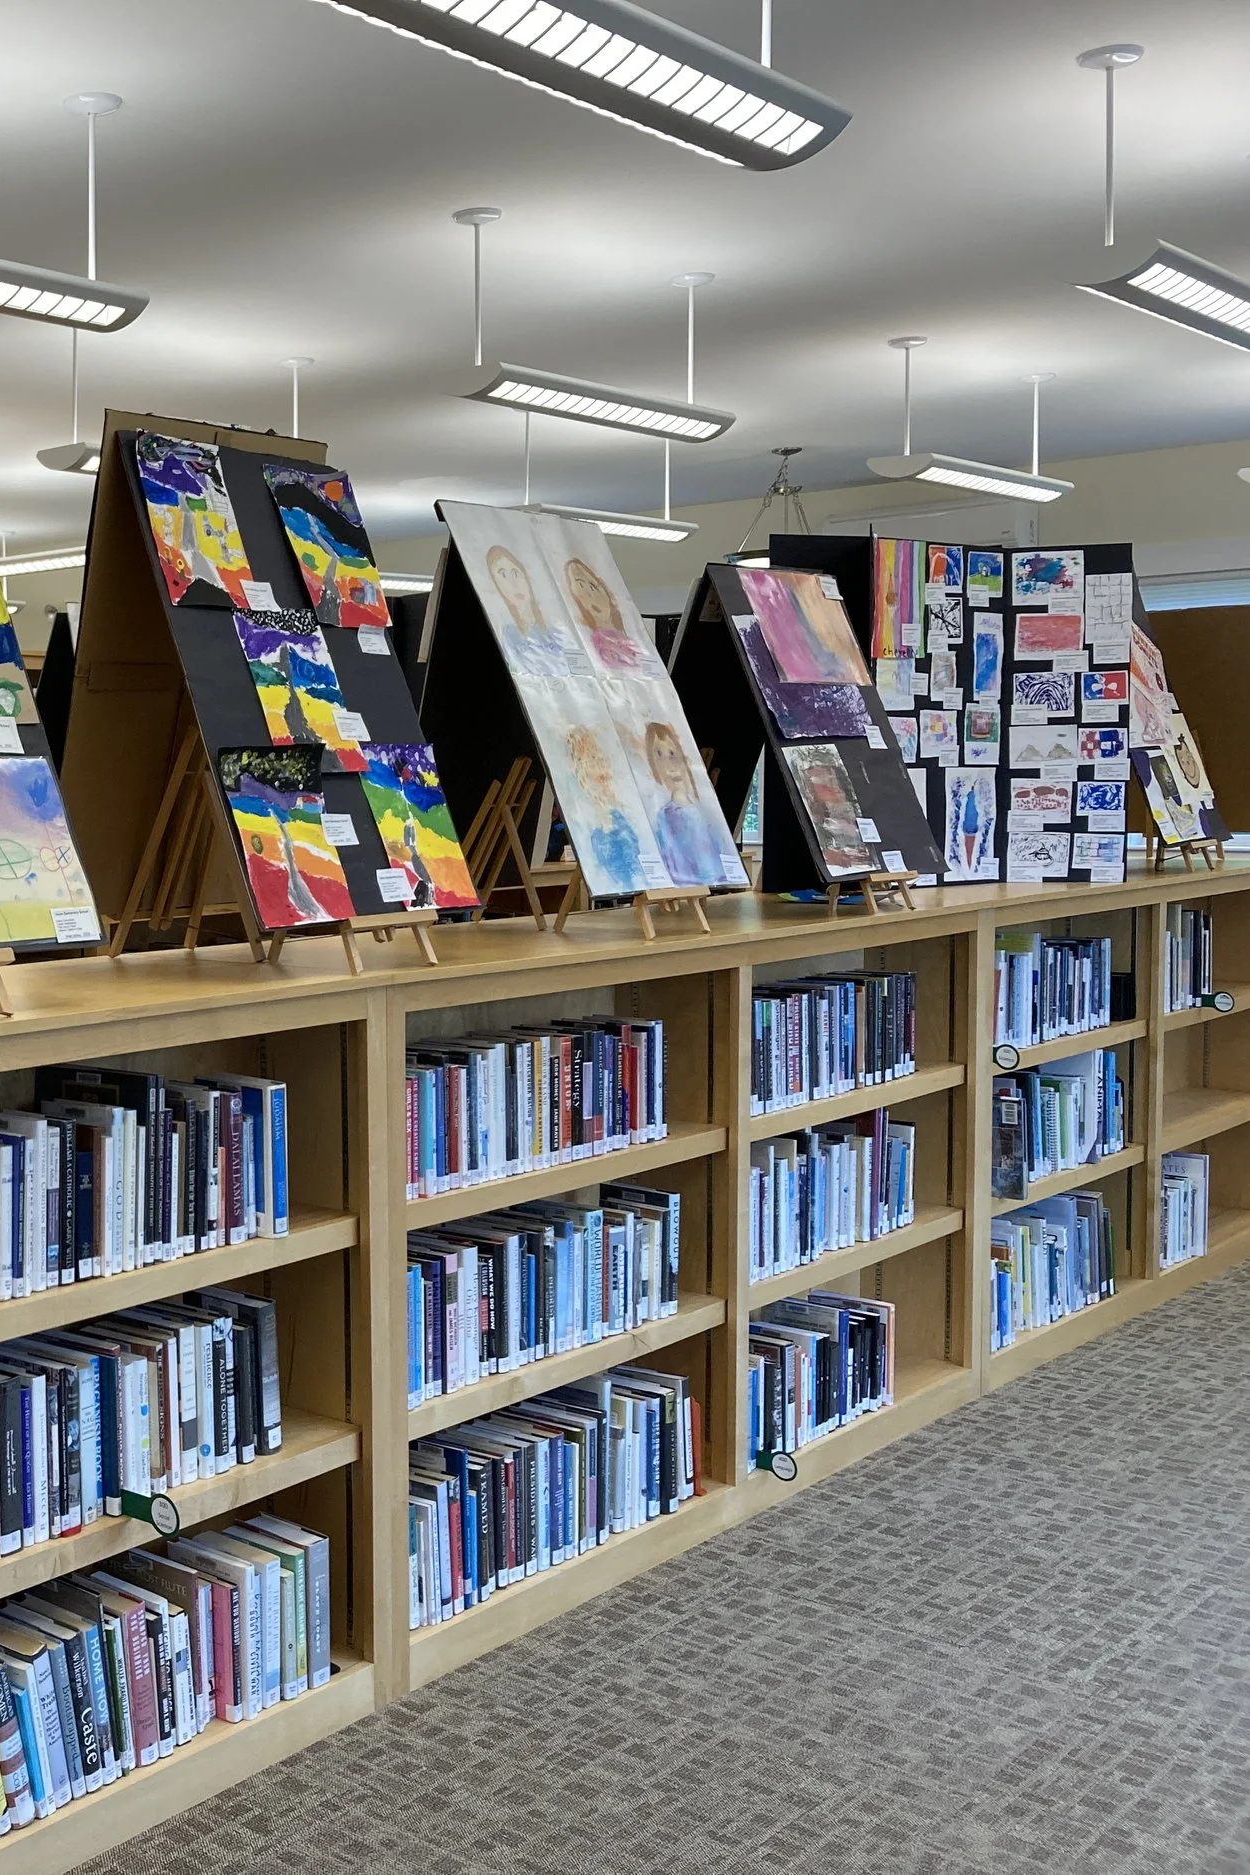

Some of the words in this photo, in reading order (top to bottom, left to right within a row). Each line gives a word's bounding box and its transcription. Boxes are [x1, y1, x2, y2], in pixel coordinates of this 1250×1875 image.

[571, 1049, 583, 1107] Strategy
[272, 1098, 280, 1139] JUDAISM
[231, 1132, 239, 1168] DALAI
[232, 1173, 240, 1215] LAMAS
[670, 1201, 680, 1261] BLOWOUT
[488, 1283, 494, 1296] WE
[489, 1298, 494, 1309] DO
[203, 1343, 214, 1388] resilience
[218, 1358, 226, 1393] ALONE
[219, 1397, 228, 1452] TOGETHER
[39, 1480, 47, 1517] MECCA
[478, 1472, 489, 1534] FRAMED
[161, 1578, 187, 1596] FLUTE
[129, 1614, 138, 1631] THE
[69, 1652, 85, 1698] Wilkerson
[88, 1637, 104, 1685] HOME
[130, 1636, 144, 1679] BEGINNING
[57, 1685, 81, 1759] Bootstrapped
[94, 1687, 108, 1724] NOW
[78, 1707, 99, 1765] Caste
